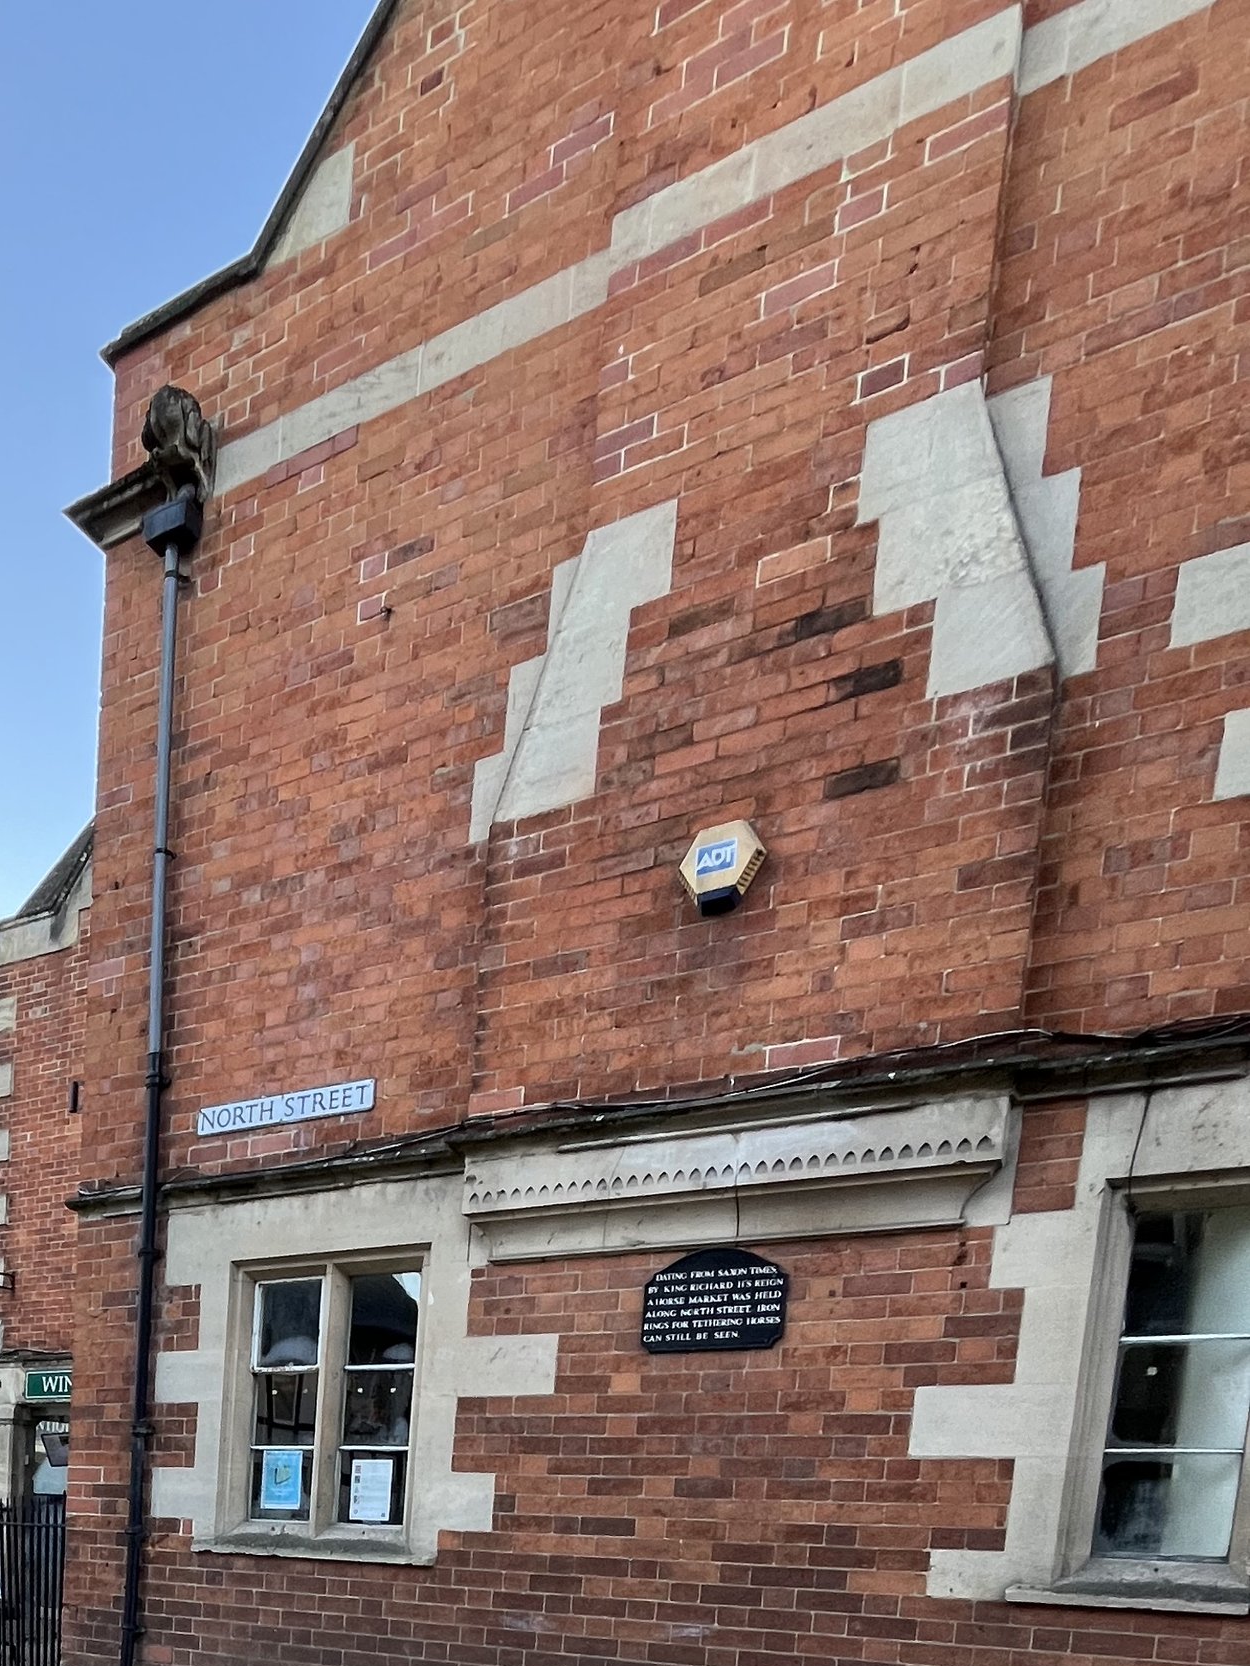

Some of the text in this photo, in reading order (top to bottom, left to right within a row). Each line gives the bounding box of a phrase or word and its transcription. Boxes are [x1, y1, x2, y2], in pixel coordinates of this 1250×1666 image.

[696, 844, 736, 871] ADT
[201, 1084, 371, 1131] NORTH STREET
[655, 1271, 688, 1282] DATING
[690, 1270, 715, 1279] FROM
[717, 1267, 748, 1277] SAXON
[648, 1286, 659, 1295] BY
[663, 1284, 688, 1293] KING
[690, 1281, 734, 1292] RICHARD
[754, 1278, 784, 1288] REIGN
[655, 1296, 686, 1306] HORSE
[688, 1293, 729, 1304] MARKET
[732, 1291, 751, 1301] WAS
[754, 1290, 782, 1300] HELD
[645, 1309, 677, 1319] ALONG
[680, 1306, 714, 1317] NORTH
[756, 1304, 781, 1313] IRON
[643, 1316, 781, 1331] RINGS FOR TETHERING HORSES
[643, 1334, 662, 1343] CAN
[665, 1332, 692, 1342] STILL
[695, 1331, 709, 1340] BE
